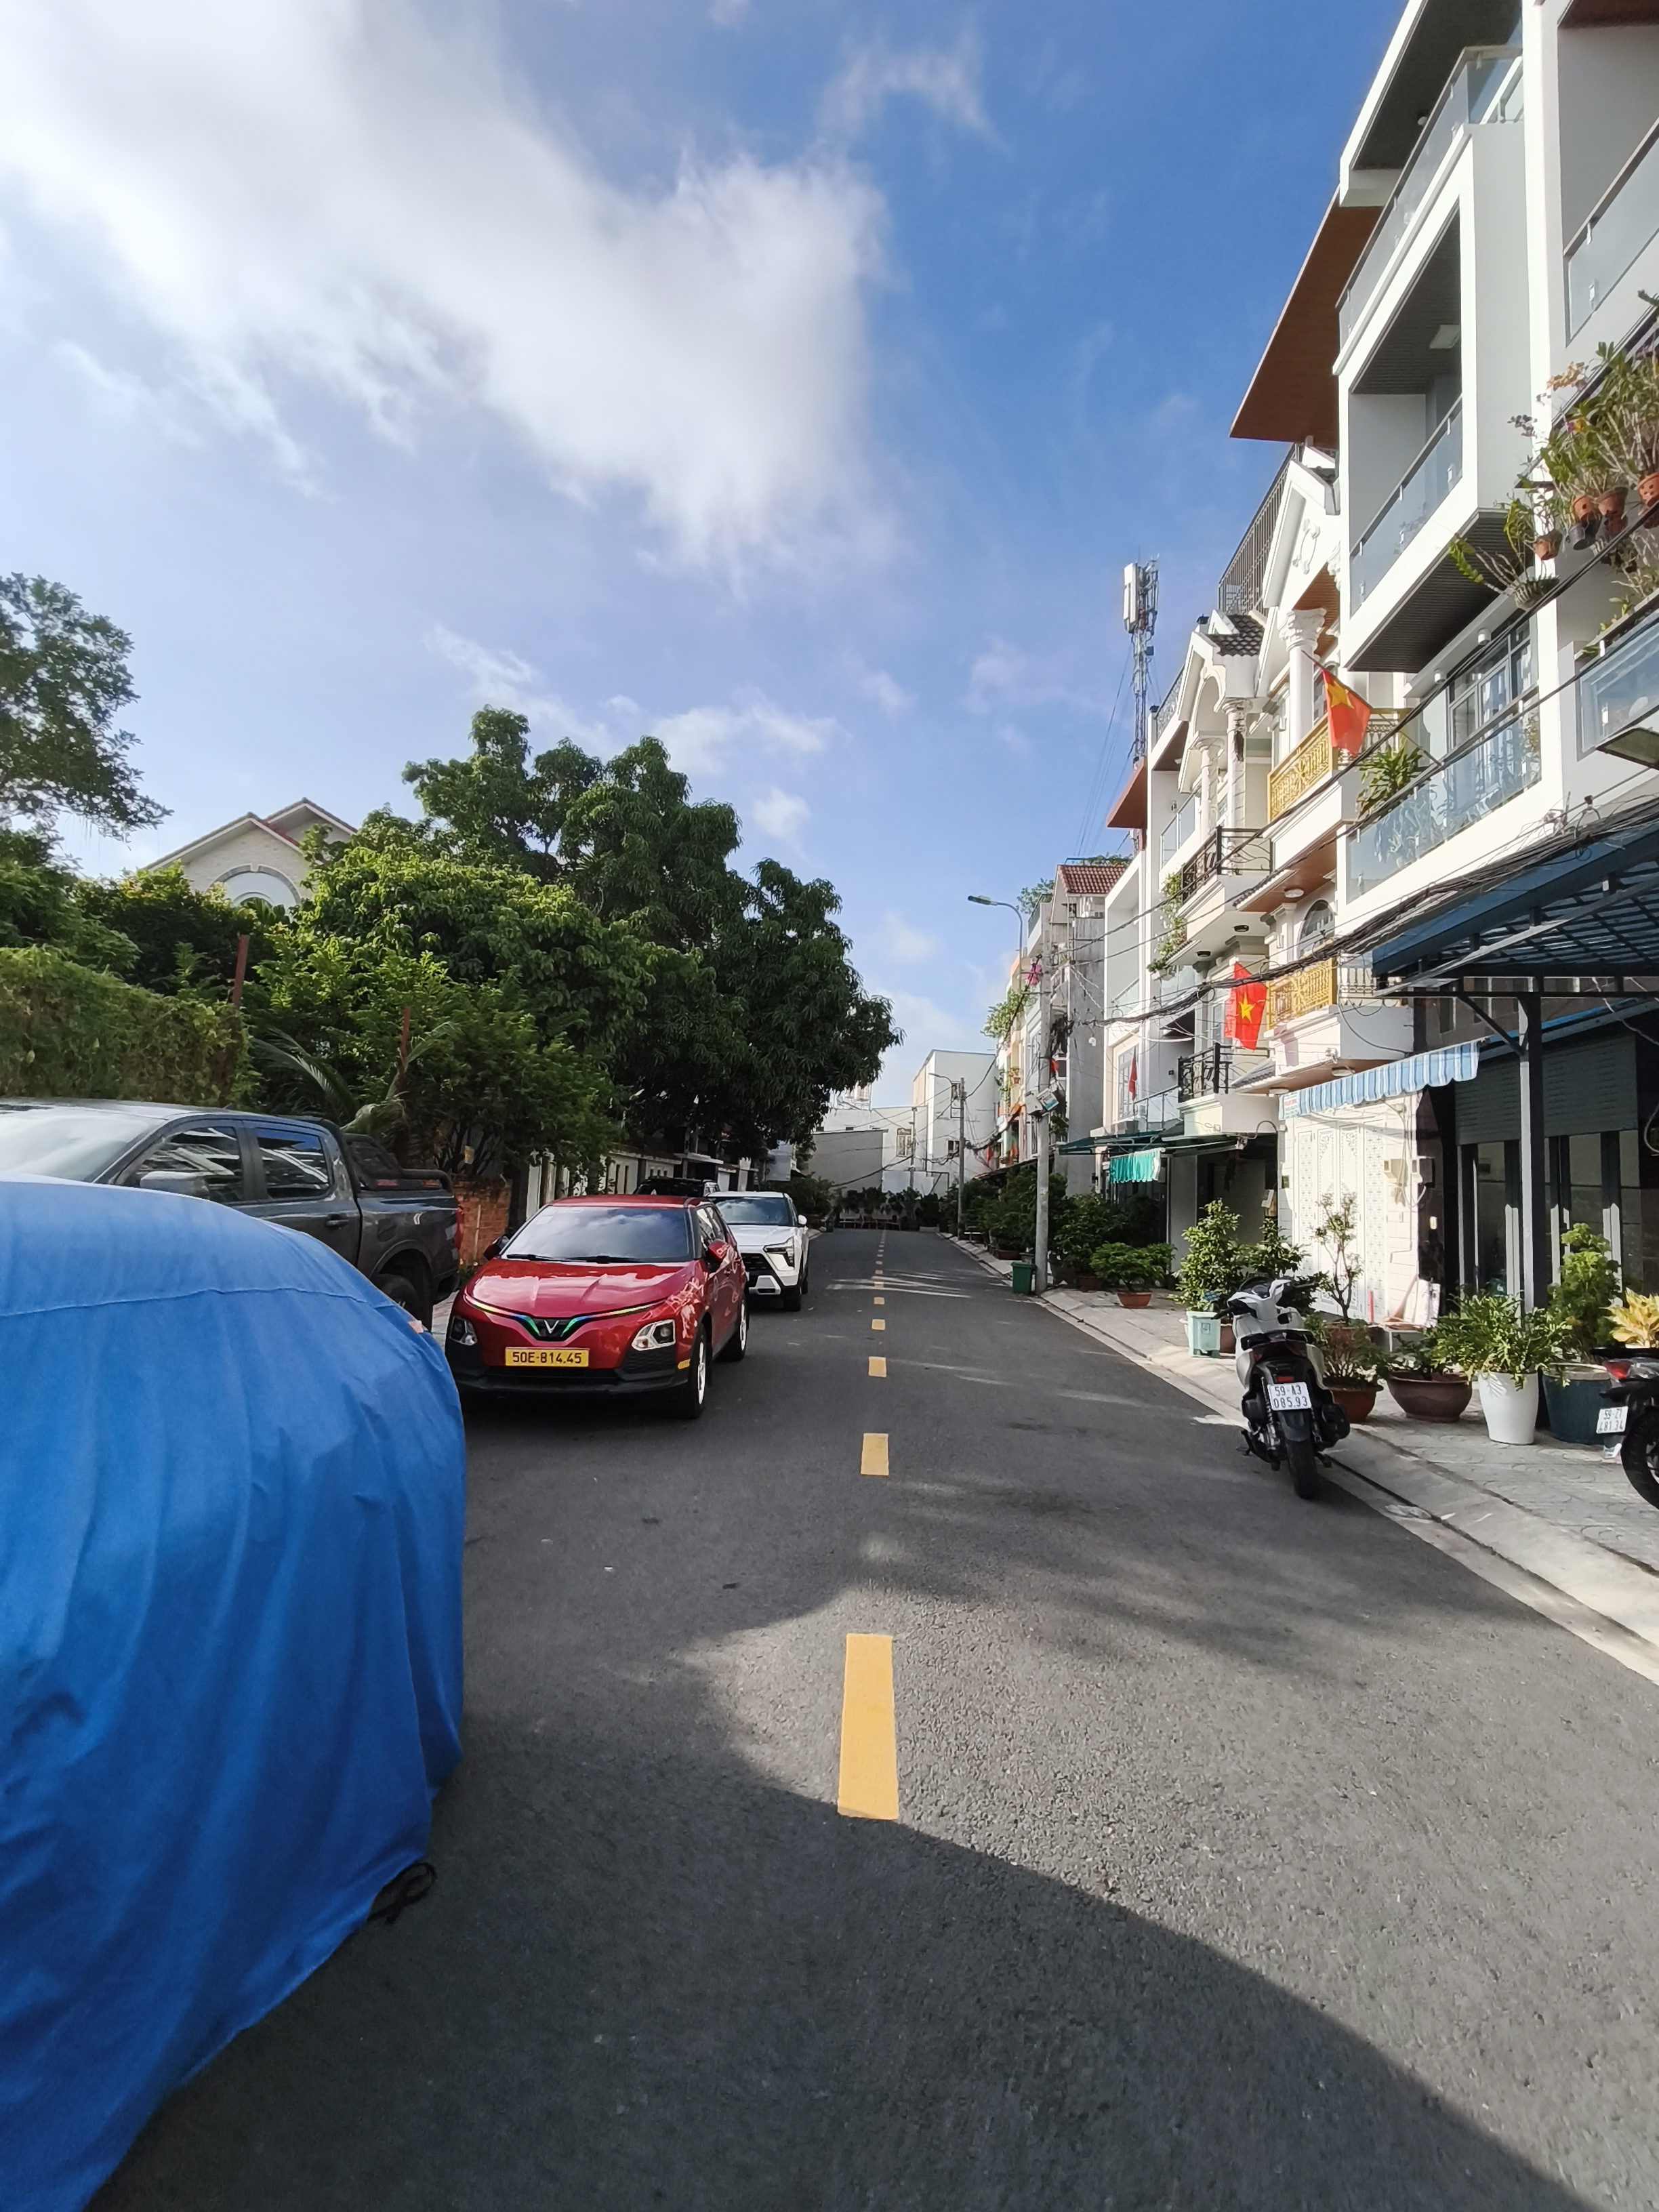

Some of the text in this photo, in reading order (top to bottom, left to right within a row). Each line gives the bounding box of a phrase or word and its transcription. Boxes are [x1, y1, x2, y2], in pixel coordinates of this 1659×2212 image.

[512, 1351, 582, 1364] 50E-814.45
[1274, 1385, 1302, 1396] 59-A3
[1273, 1396, 1308, 1408] 085.93
